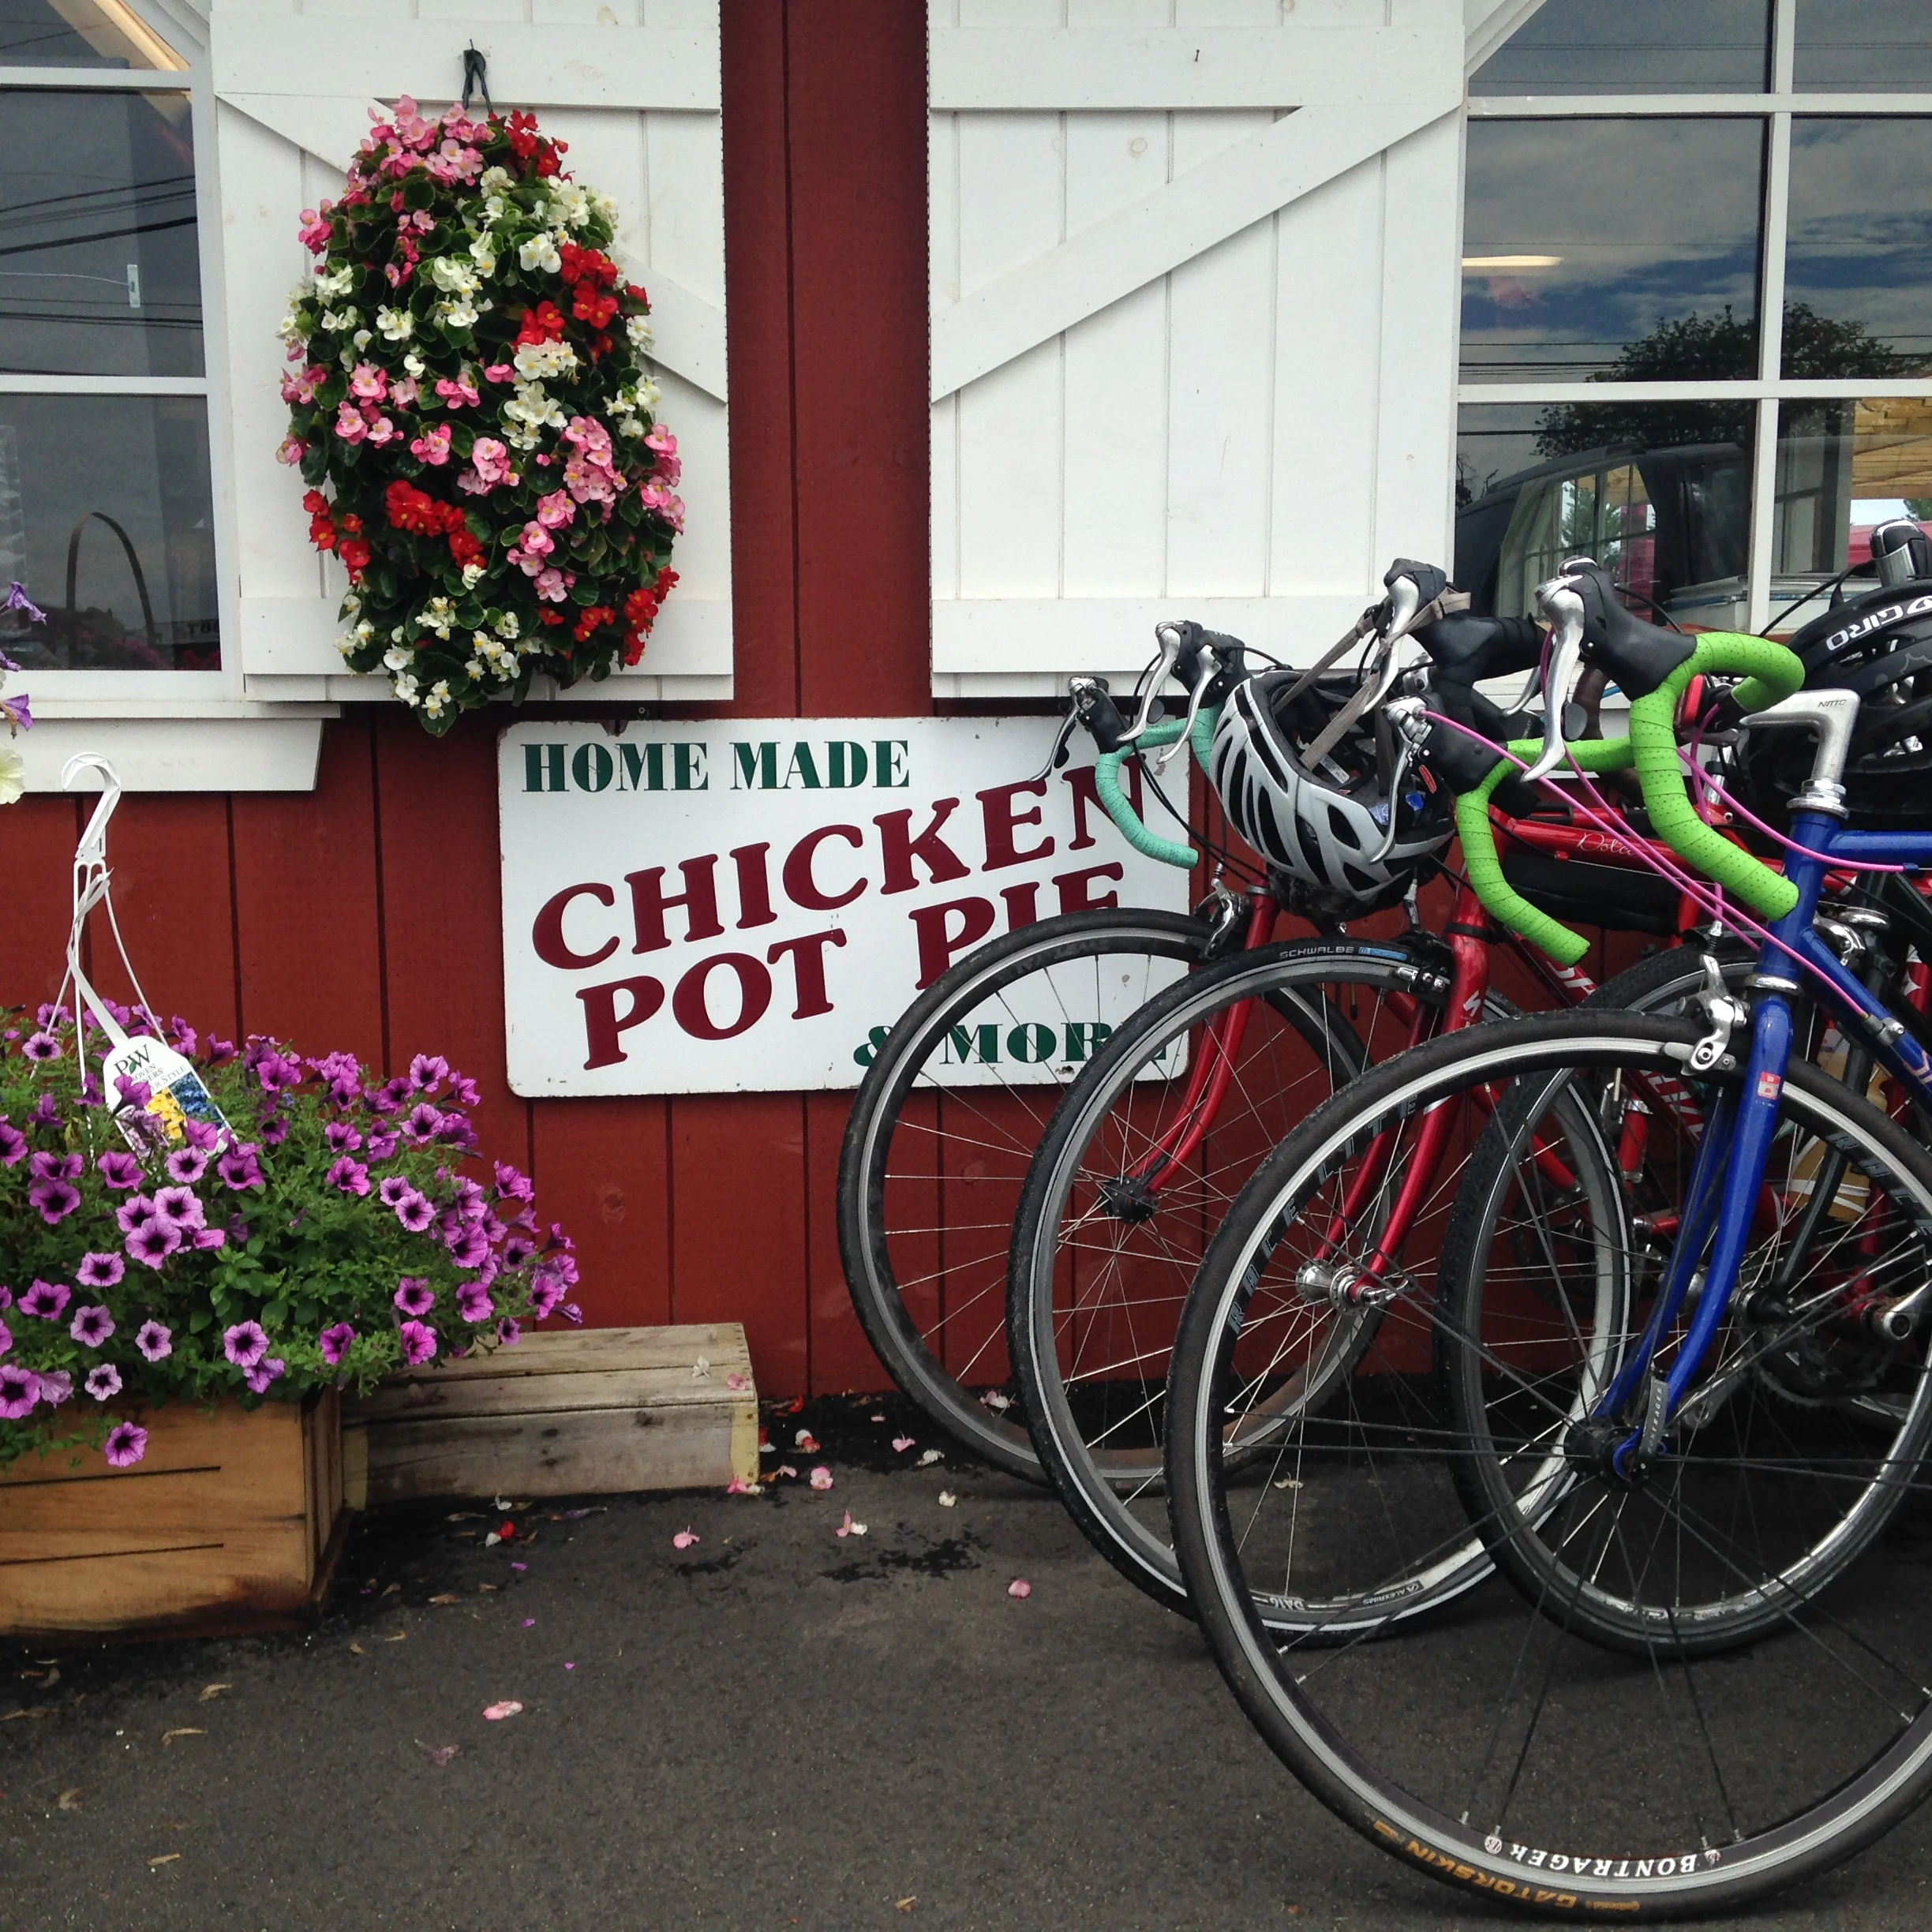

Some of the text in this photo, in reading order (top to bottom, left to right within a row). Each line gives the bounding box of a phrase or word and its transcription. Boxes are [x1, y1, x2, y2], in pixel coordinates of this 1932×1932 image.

[1826, 605, 1904, 651] GIRO
[521, 739, 911, 793] HOME MADE
[532, 753, 1146, 971] CHICKEN
[577, 862, 1124, 1071] POT PIE
[1279, 945, 1355, 960] SCHWALBE
[114, 1043, 150, 1075] PW
[939, 1022, 1167, 1065] MOR
[1406, 1840, 1578, 1909] GATORSKIN
[1510, 1844, 1697, 1878] BONTRAGER
